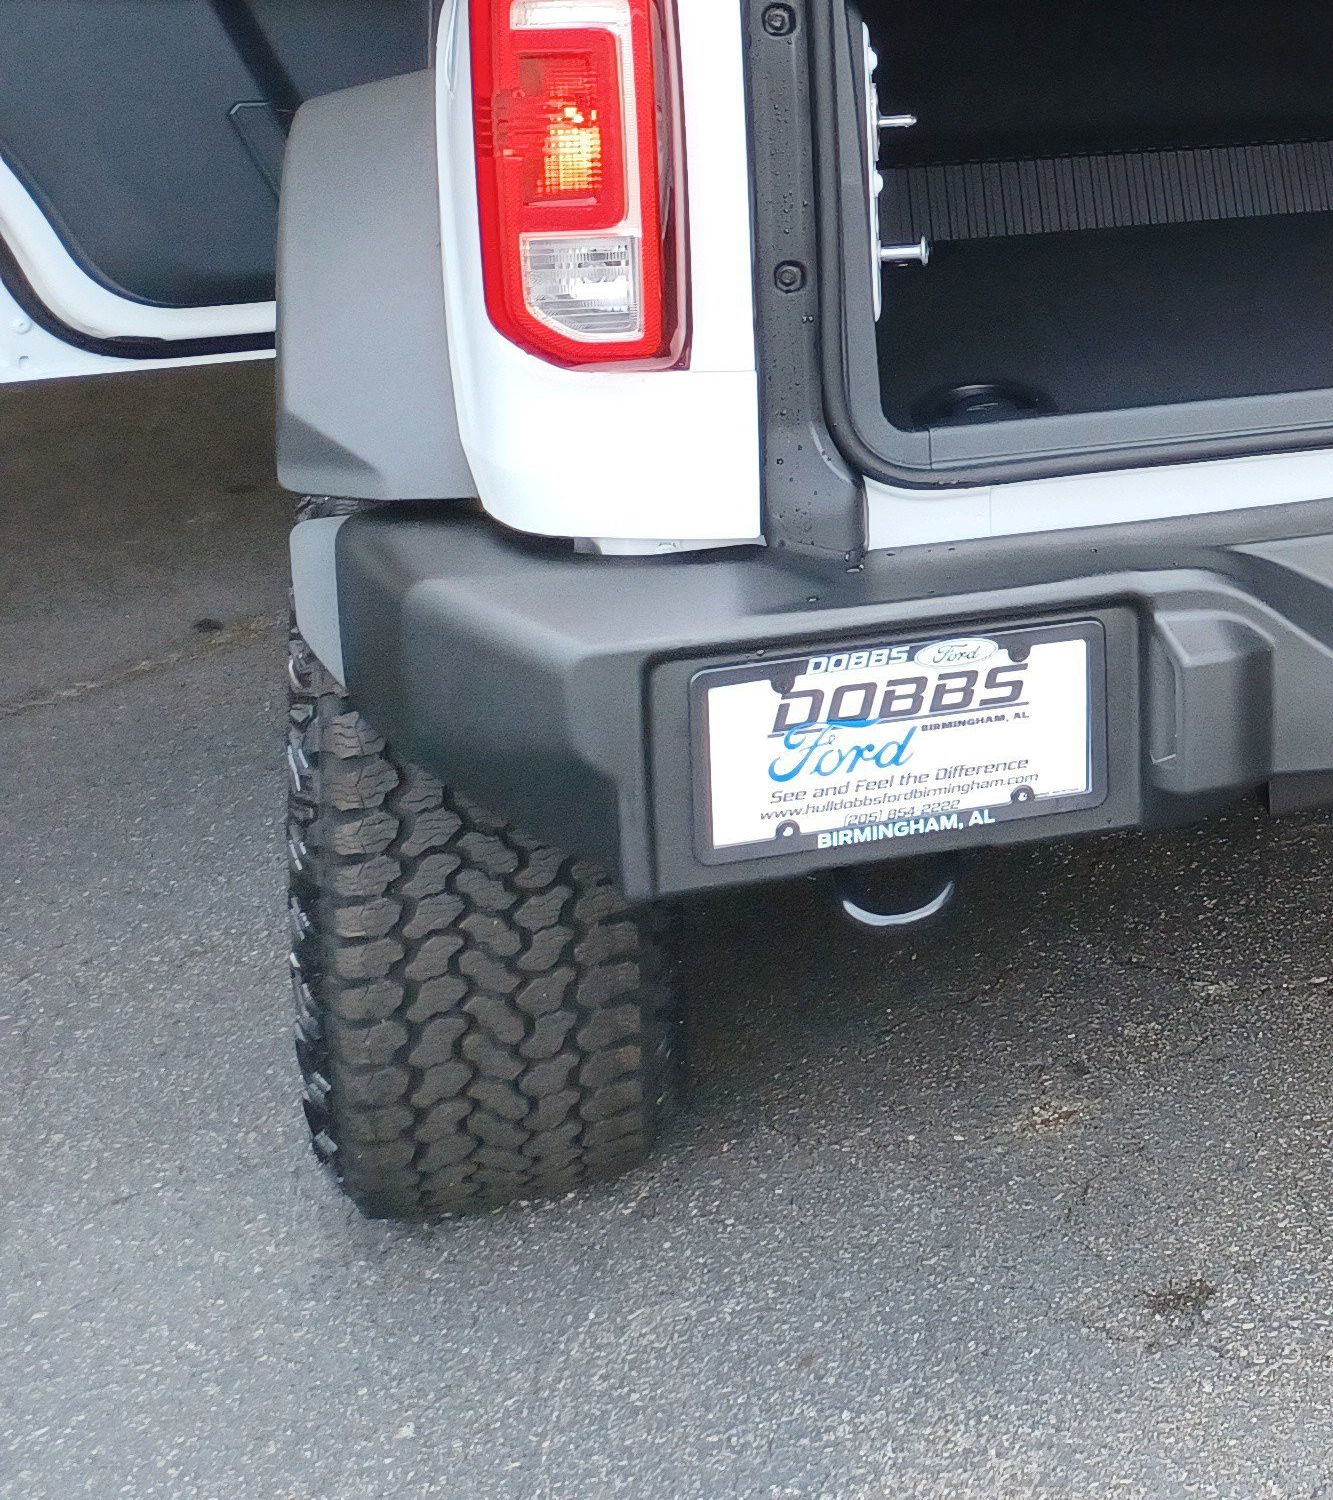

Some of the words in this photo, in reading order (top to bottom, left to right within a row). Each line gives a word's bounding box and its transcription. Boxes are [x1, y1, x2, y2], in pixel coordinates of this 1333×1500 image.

[805, 646, 911, 676] DOBBS
[932, 643, 981, 663] Ford
[772, 663, 1029, 733] DOBBS
[921, 714, 1010, 732] BIRMINGHAM,
[1013, 711, 1030, 720] AL
[768, 717, 918, 783] Ford
[760, 773, 1039, 821] www.hulldobbsfordbirmingham.com
[769, 791, 807, 805] See
[812, 782, 849, 799] and
[854, 775, 894, 793] Feel
[899, 771, 930, 787] the
[934, 758, 1029, 782] Difference
[817, 813, 964, 849] BIRMINGHAM,
[968, 808, 996, 825] AL
[843, 809, 883, 828] (205)
[886, 799, 961, 820] 854-2222
